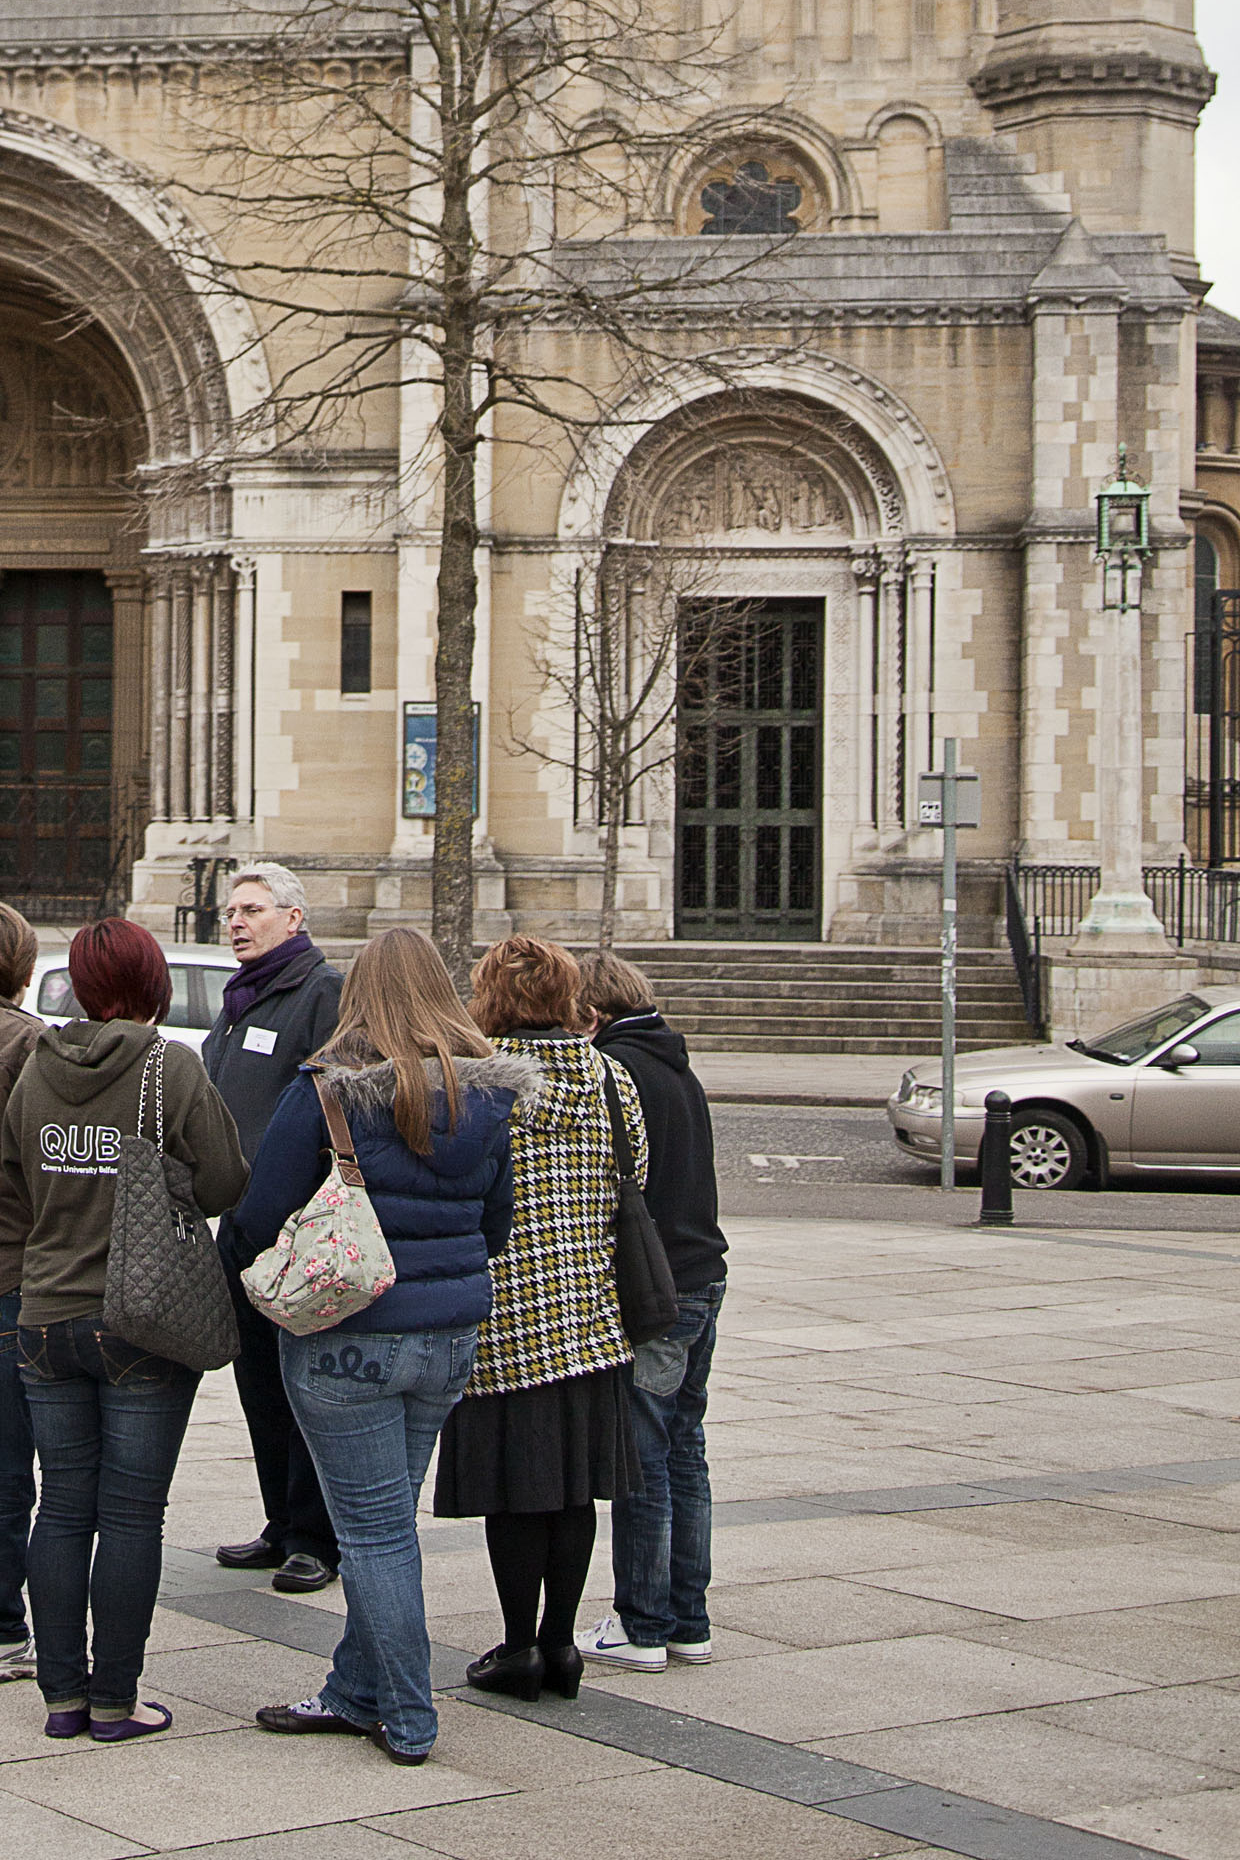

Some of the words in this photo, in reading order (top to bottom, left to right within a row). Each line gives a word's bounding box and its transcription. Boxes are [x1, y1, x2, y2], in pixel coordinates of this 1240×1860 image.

[40, 1123, 121, 1162] QUB
[62, 1164, 98, 1175] University
[98, 1165, 118, 1174] Belfas
